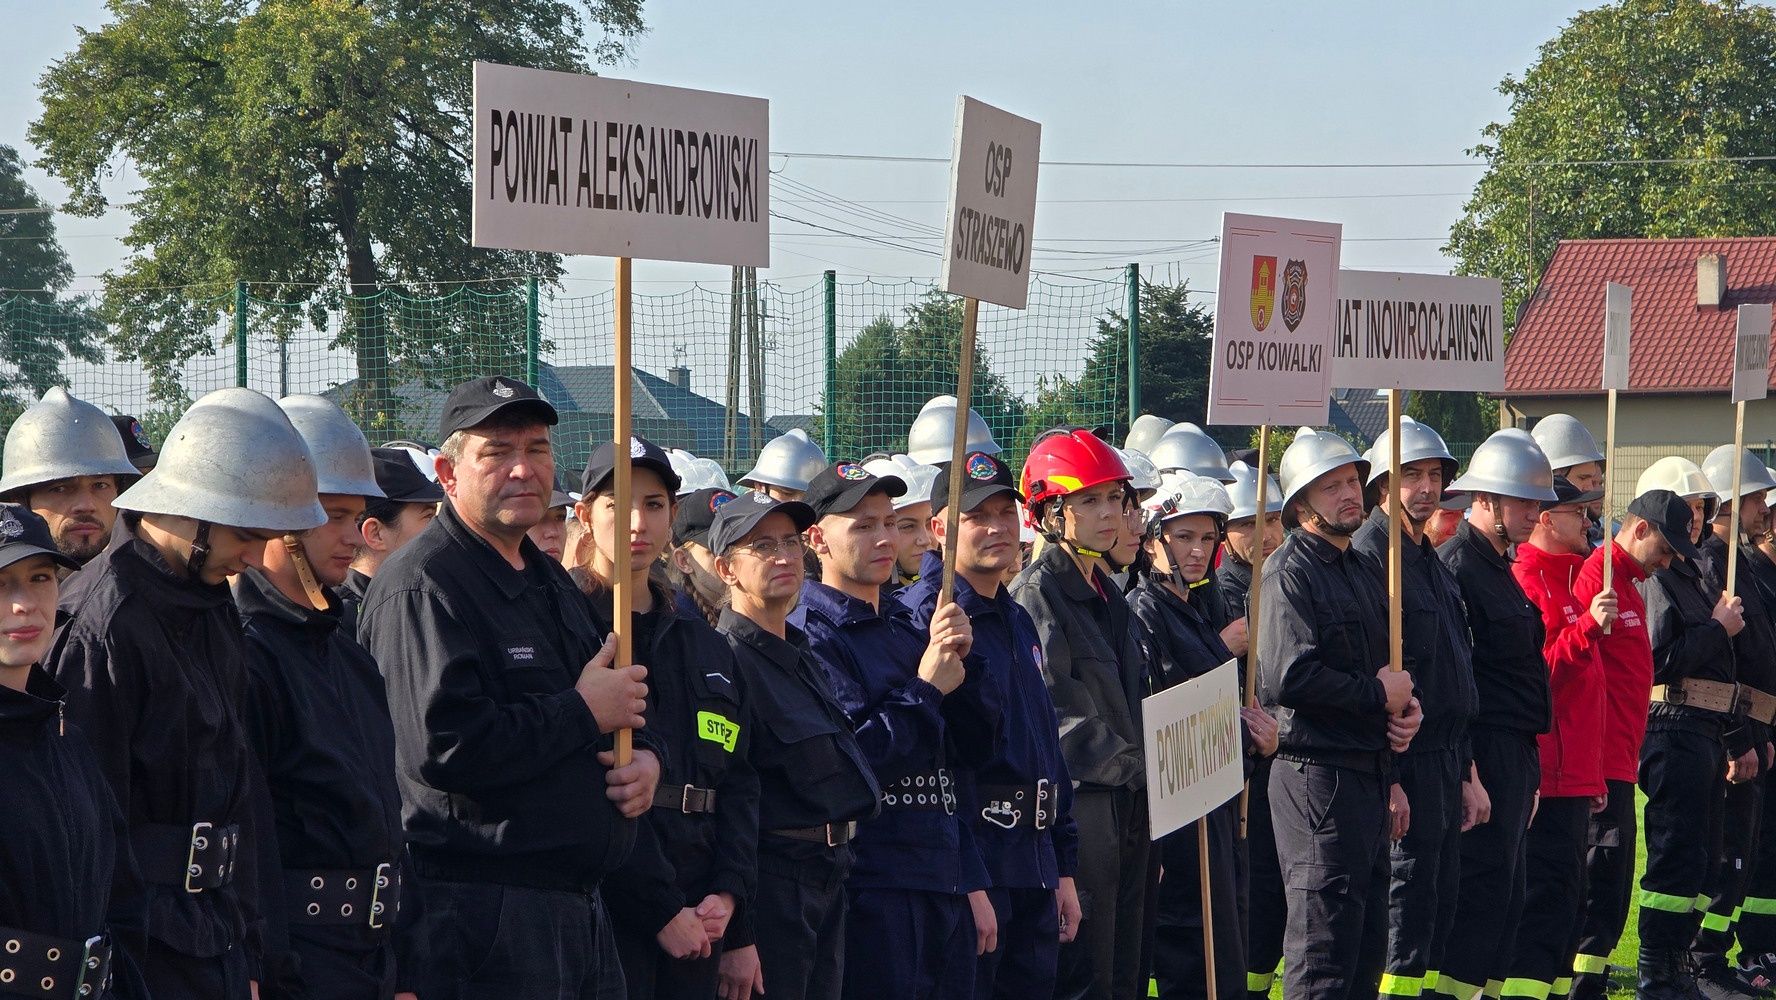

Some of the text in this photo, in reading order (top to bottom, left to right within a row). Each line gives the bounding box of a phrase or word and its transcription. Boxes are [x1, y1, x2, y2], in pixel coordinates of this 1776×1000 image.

[490, 109, 758, 222] POWIAT ALEKSANDROWSKI
[984, 140, 1012, 198] OSP
[956, 206, 1024, 275] STRASZEWO
[1226, 340, 1322, 373] OSP KOWALKI
[1332, 298, 1493, 362] IAT INOWROCŁAWSKI
[706, 719, 733, 743] STRZ
[1156, 713, 1199, 799] POWIAT
